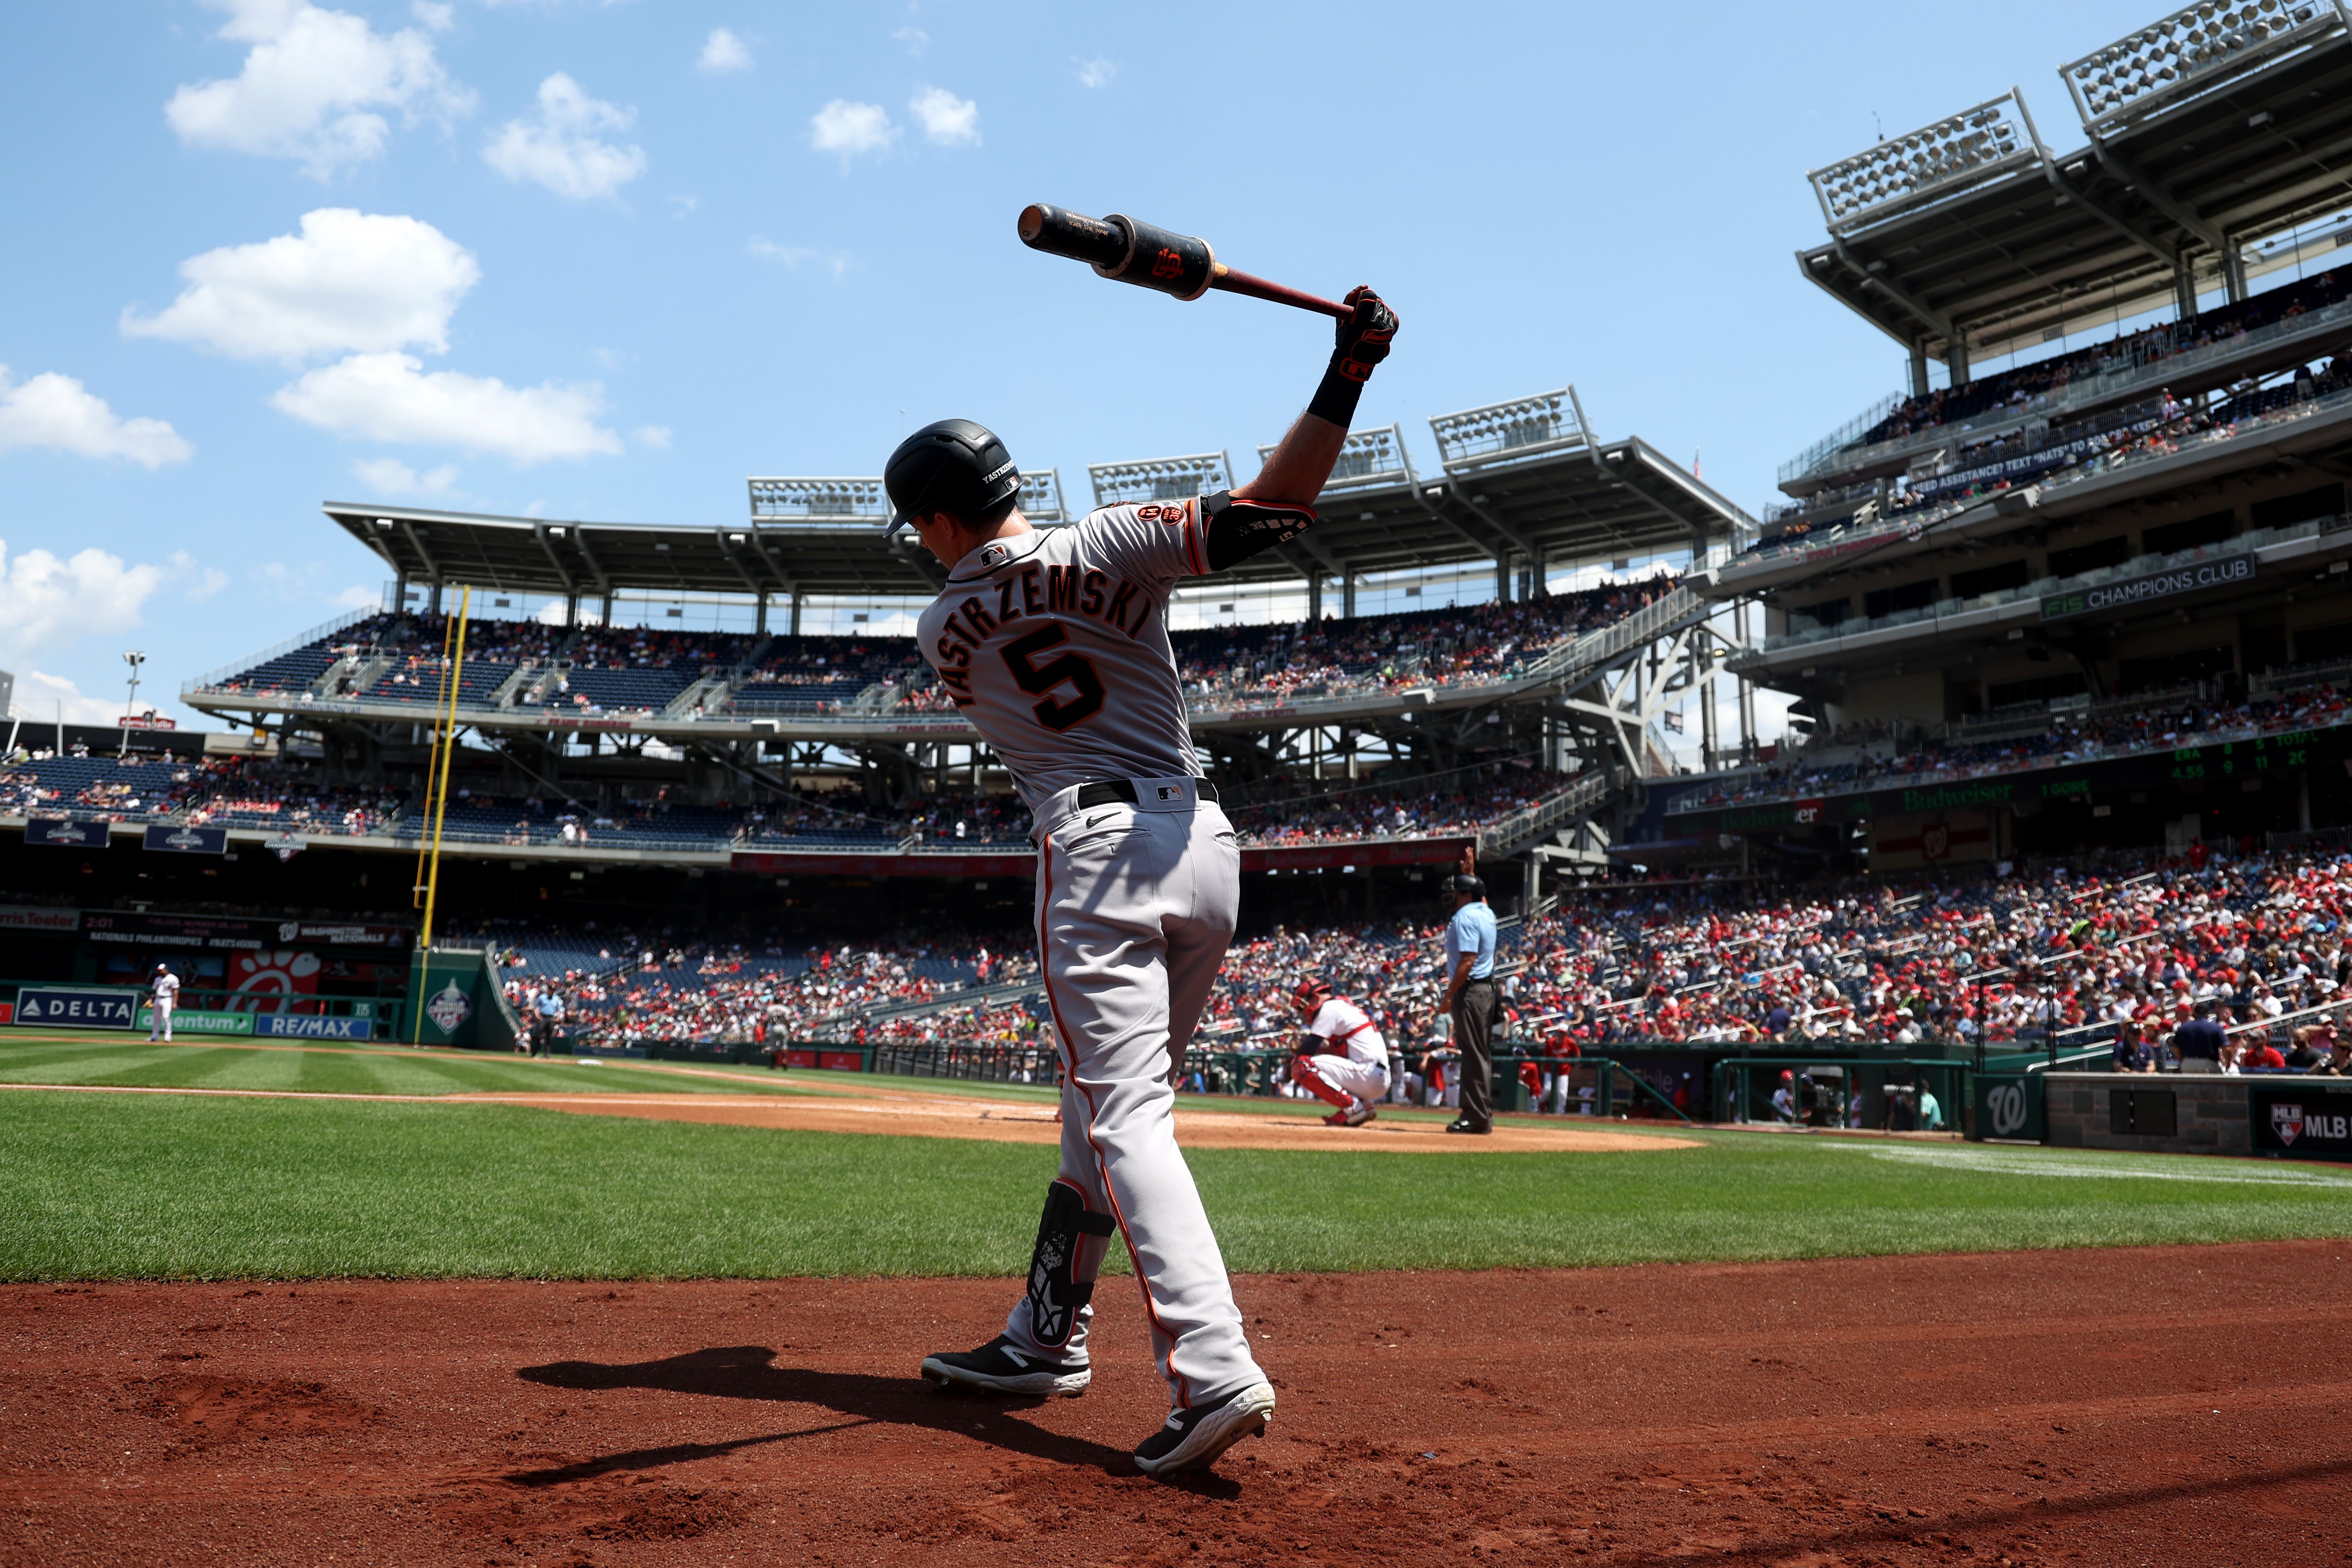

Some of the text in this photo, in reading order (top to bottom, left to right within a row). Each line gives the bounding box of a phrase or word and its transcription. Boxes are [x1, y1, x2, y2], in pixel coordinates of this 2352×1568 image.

[982, 459, 1016, 484] YASTRZEMSK
[1913, 478, 1937, 493] NEED
[1938, 461, 2003, 489] ASSISTANCE?
[2005, 456, 2031, 472] TEXT
[2070, 438, 2085, 452] TO
[1170, 509, 1181, 520] 36
[2087, 572, 2193, 608] CHAMPIONS
[2197, 559, 2248, 585] CLUB
[937, 564, 1151, 709] YASTRZEMSKI
[998, 620, 1107, 734] 5
[292, 702, 346, 713] ROBINSON
[2276, 730, 2319, 747] TOTAL
[2254, 755, 2268, 770] 11
[1904, 783, 2013, 812] Budweiser
[1721, 805, 1818, 831] Budweiser
[46, 829, 86, 841] CHAMPIONS
[165, 837, 204, 846] CHAMPIONS
[264, 842, 308, 851] CHAMPIONS
[27, 912, 74, 927] Teeter
[85, 916, 114, 929] 2:01
[300, 926, 366, 936] WASHINGTON
[329, 933, 386, 944] NATIONALS
[89, 931, 134, 943] NATIONALS
[135, 933, 203, 947] PHILANTHROPIES
[48, 999, 131, 1019] DELTA
[142, 1015, 234, 1030] aentum
[271, 1018, 352, 1038] RE/MAX
[2274, 1107, 2301, 1118] MLB
[2304, 1114, 2348, 1139] MLB
